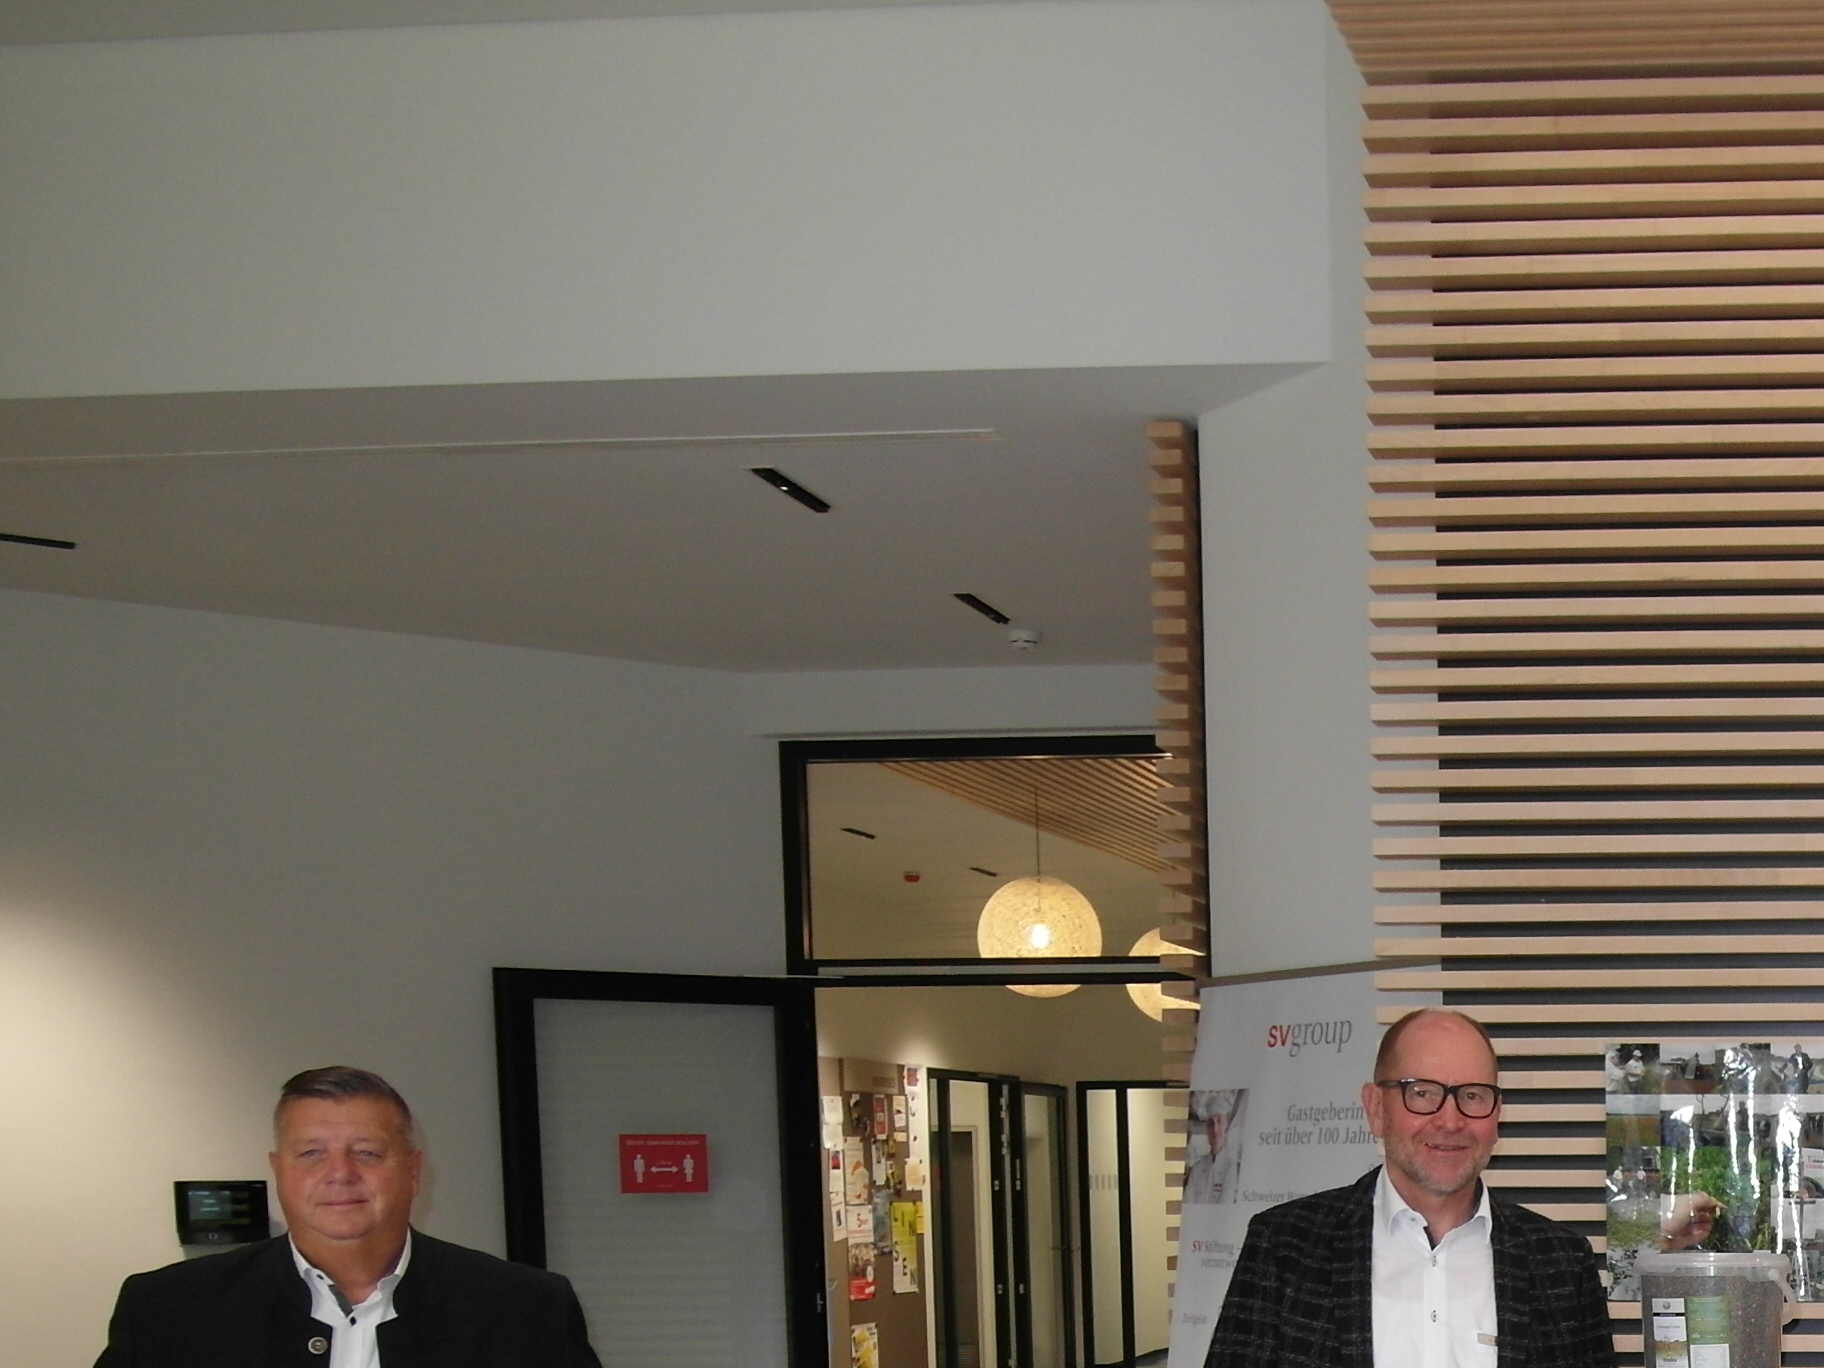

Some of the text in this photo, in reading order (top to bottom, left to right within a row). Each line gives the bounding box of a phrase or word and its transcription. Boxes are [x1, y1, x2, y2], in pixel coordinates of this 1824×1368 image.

[1267, 1019, 1352, 1057] svgroup
[1286, 1101, 1365, 1124] Gastgeberin
[1258, 1126, 1283, 1146] seit
[1285, 1125, 1314, 1146] über
[1316, 1126, 1340, 1145] 100
